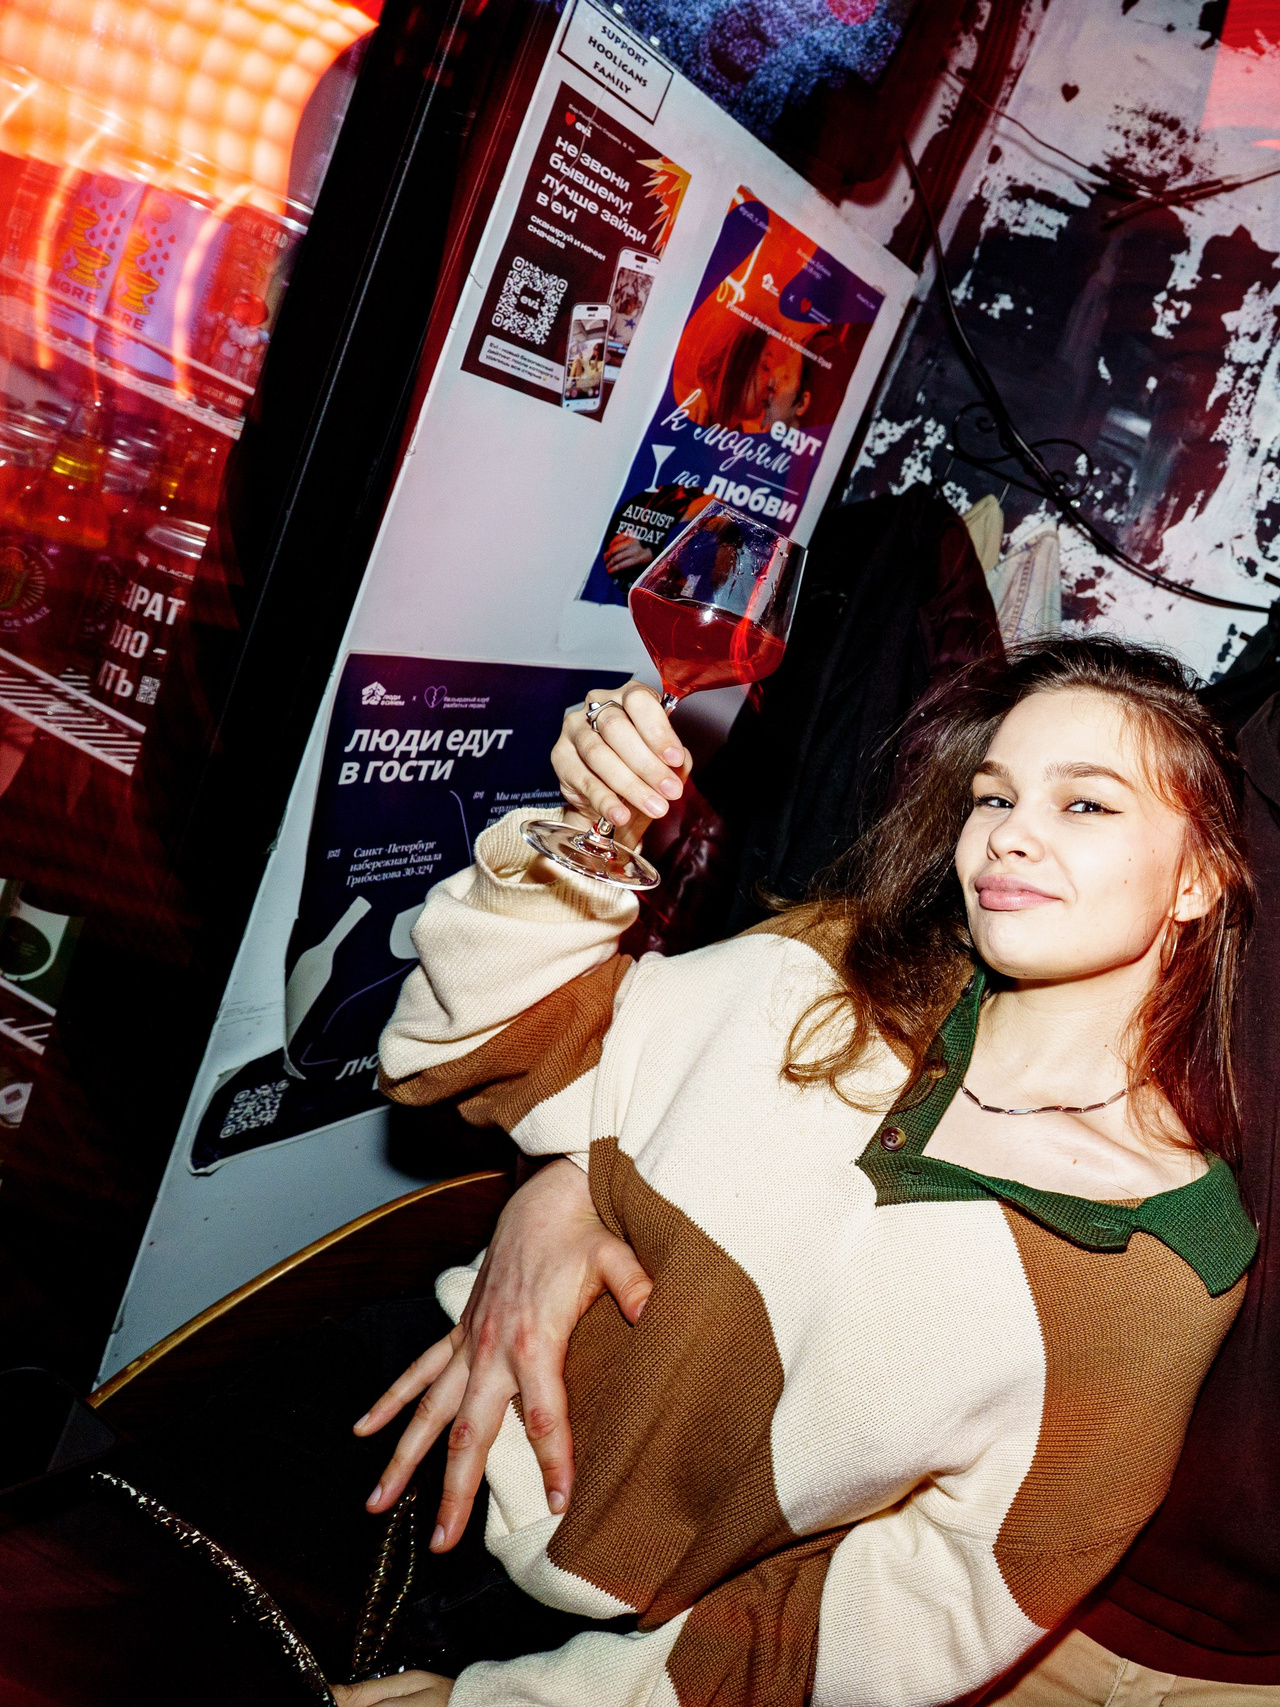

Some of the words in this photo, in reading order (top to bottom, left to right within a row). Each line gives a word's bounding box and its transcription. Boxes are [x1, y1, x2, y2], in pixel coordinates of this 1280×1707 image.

[588, 35, 648, 87] HOOLIGANS
[601, 25, 648, 67] SUPPORT
[593, 61, 632, 94] FAMILY
[575, 121, 593, 138] evi
[555, 136, 579, 158] не
[580, 153, 630, 193] звони
[549, 152, 633, 215] бывшему!
[536, 191, 550, 207] в
[551, 200, 578, 223] evi
[541, 173, 599, 214] лучше
[600, 208, 648, 245] зайди
[527, 224, 566, 249] сначала
[530, 215, 574, 244] сканируй
[574, 239, 581, 248] и
[580, 242, 606, 262] начни
[520, 295, 541, 311] evi
[693, 423, 792, 474] людям
[770, 421, 823, 457] едут
[672, 470, 701, 489] по
[622, 504, 675, 529] AUGUST
[616, 521, 665, 545] FRIDAY
[446, 728, 514, 758] едут
[350, 857, 408, 873] набережная
[409, 851, 443, 864] Канала
[353, 846, 383, 859] Санкт
[346, 870, 402, 888] Грибоедова
